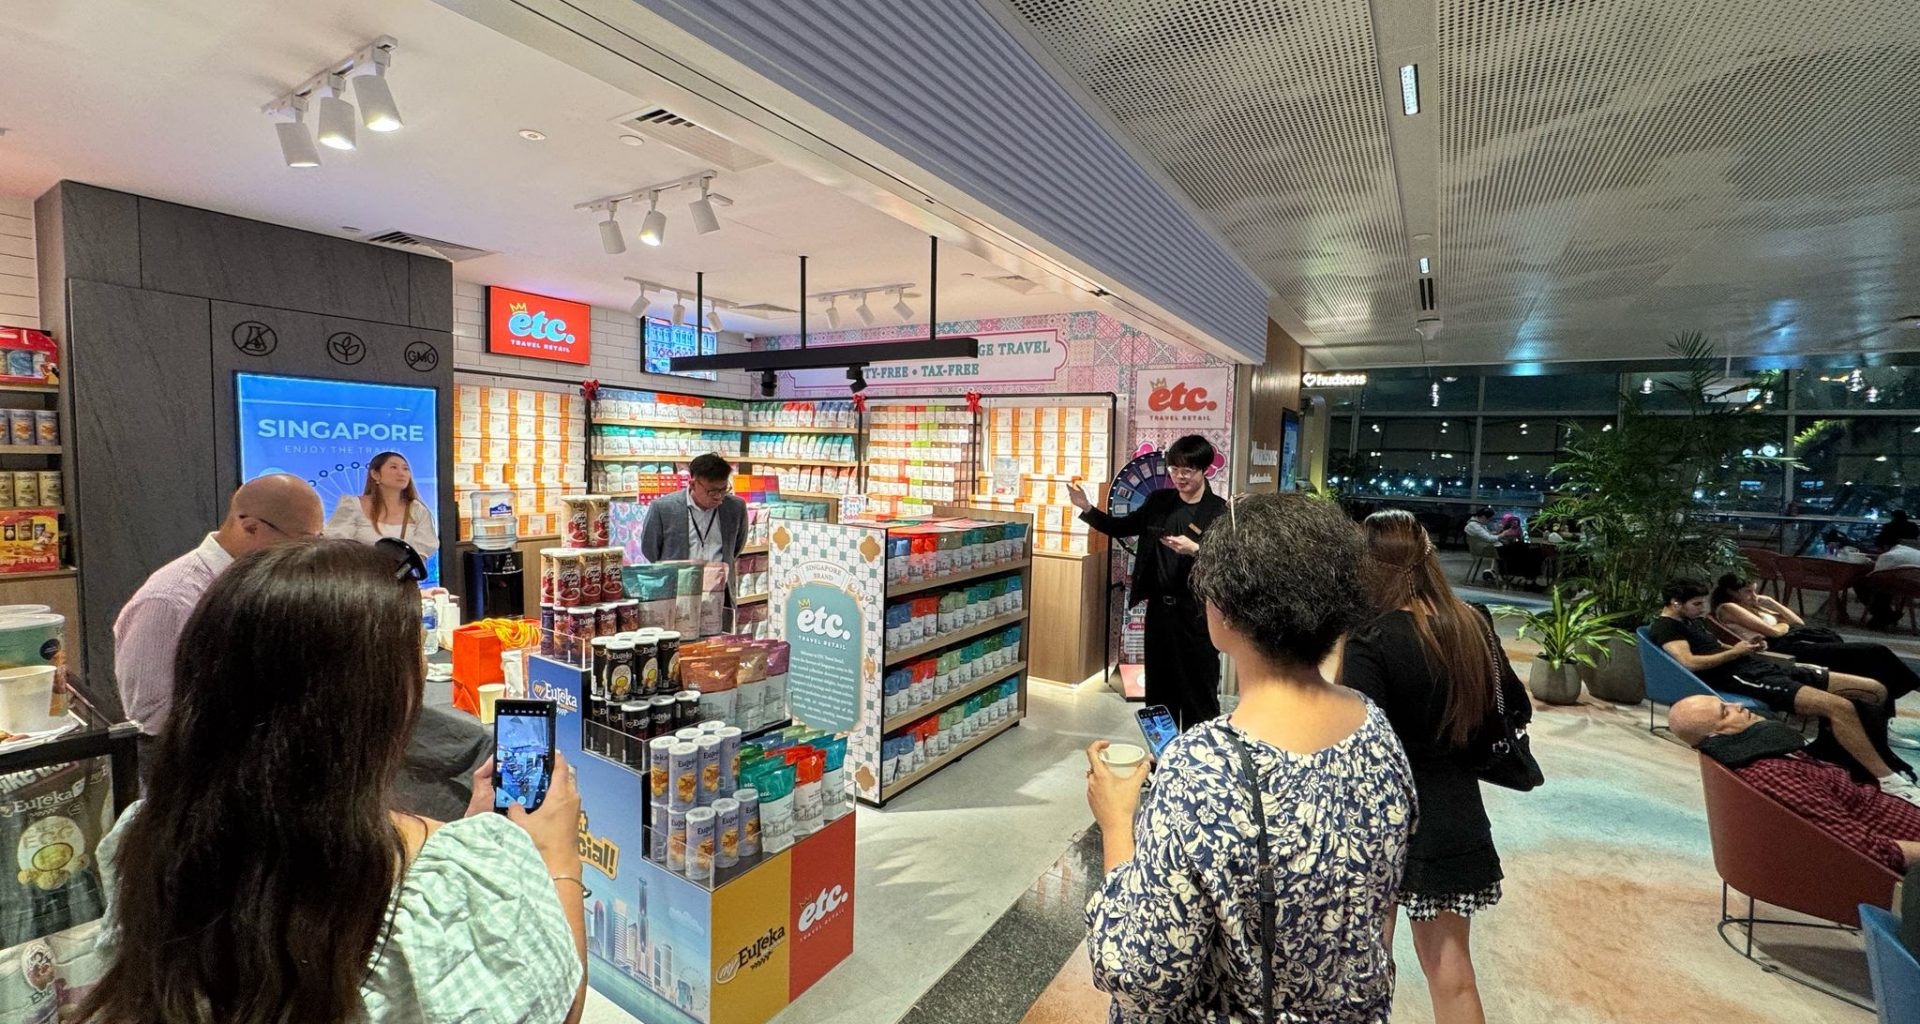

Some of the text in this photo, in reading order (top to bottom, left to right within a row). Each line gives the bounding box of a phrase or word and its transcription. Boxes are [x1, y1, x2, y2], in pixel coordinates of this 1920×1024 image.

[508, 310, 576, 344] etc.
[407, 350, 435, 364] GMO
[511, 339, 571, 353] TRAVEL RETAIL
[997, 340, 1050, 356] TRAVEL
[921, 363, 980, 377] TAX-FREE
[1316, 373, 1367, 386] hudsons
[1148, 382, 1218, 412] etc.
[258, 419, 424, 442] SINGAPORE
[284, 445, 327, 454] ENJOY
[336, 446, 354, 454] THE
[806, 564, 842, 575] SINGAPORE
[797, 606, 851, 640] etc.
[798, 635, 847, 651] TRAVEL RETAIL
[545, 683, 578, 707] Eureka
[13, 790, 73, 813] Eureka
[578, 836, 615, 874] cial!
[798, 884, 849, 932] etc.
[738, 926, 786, 969] Eureka
